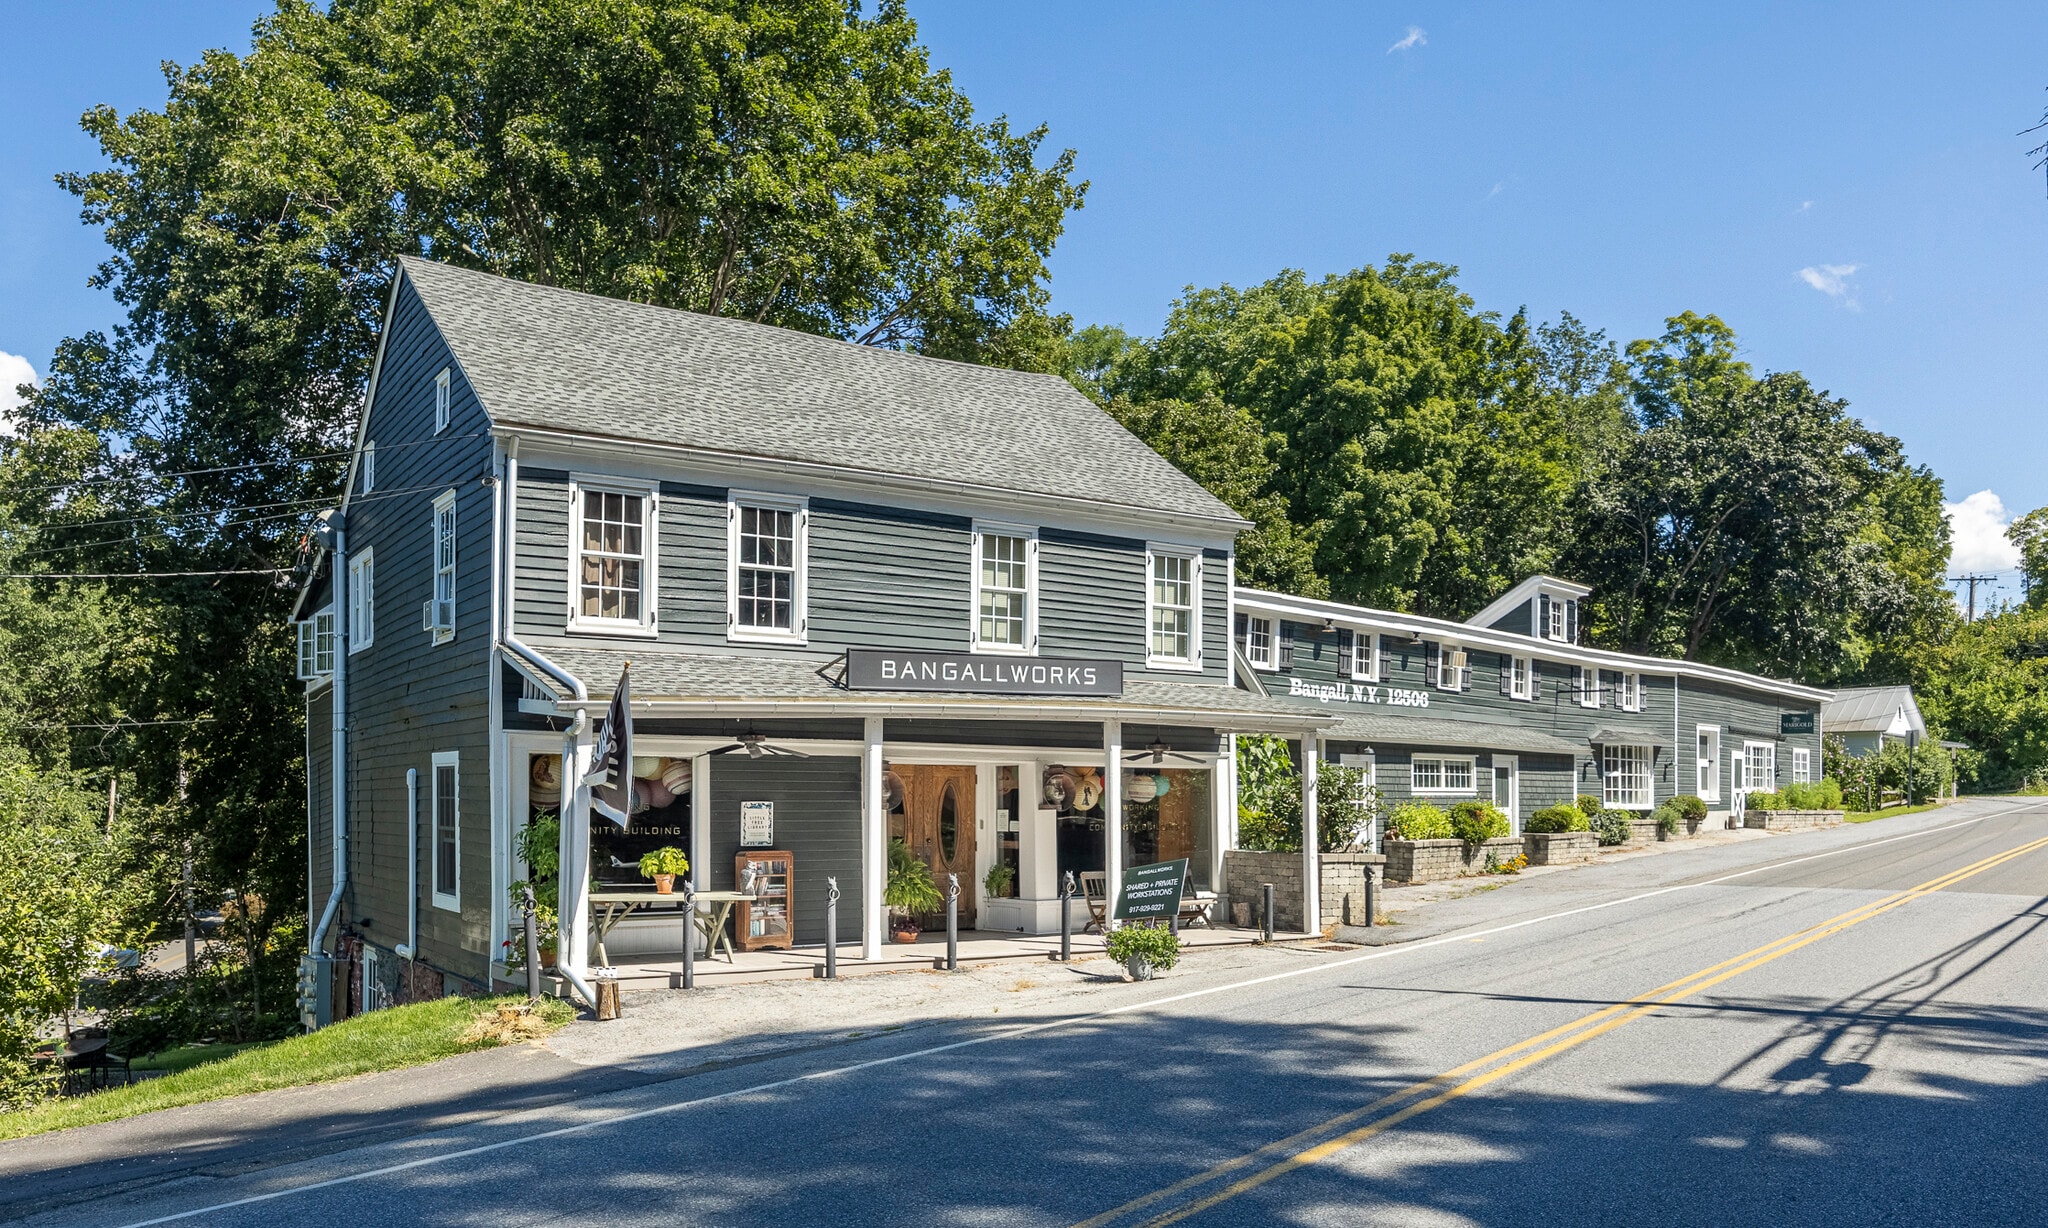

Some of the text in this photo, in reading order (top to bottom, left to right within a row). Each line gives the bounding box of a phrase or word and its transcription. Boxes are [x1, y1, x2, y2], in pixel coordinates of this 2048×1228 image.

[881, 660, 1097, 685] BANGALLWORKS
[1288, 677, 1429, 708] Bangall, N.Y. 12506
[623, 826, 681, 835] BUILDING
[1137, 865, 1173, 876] BANGALLWORKS
[1125, 882, 1149, 892] SHARED
[1154, 878, 1179, 888] PRIVATE
[1127, 888, 1173, 900] WORKSTATIONS
